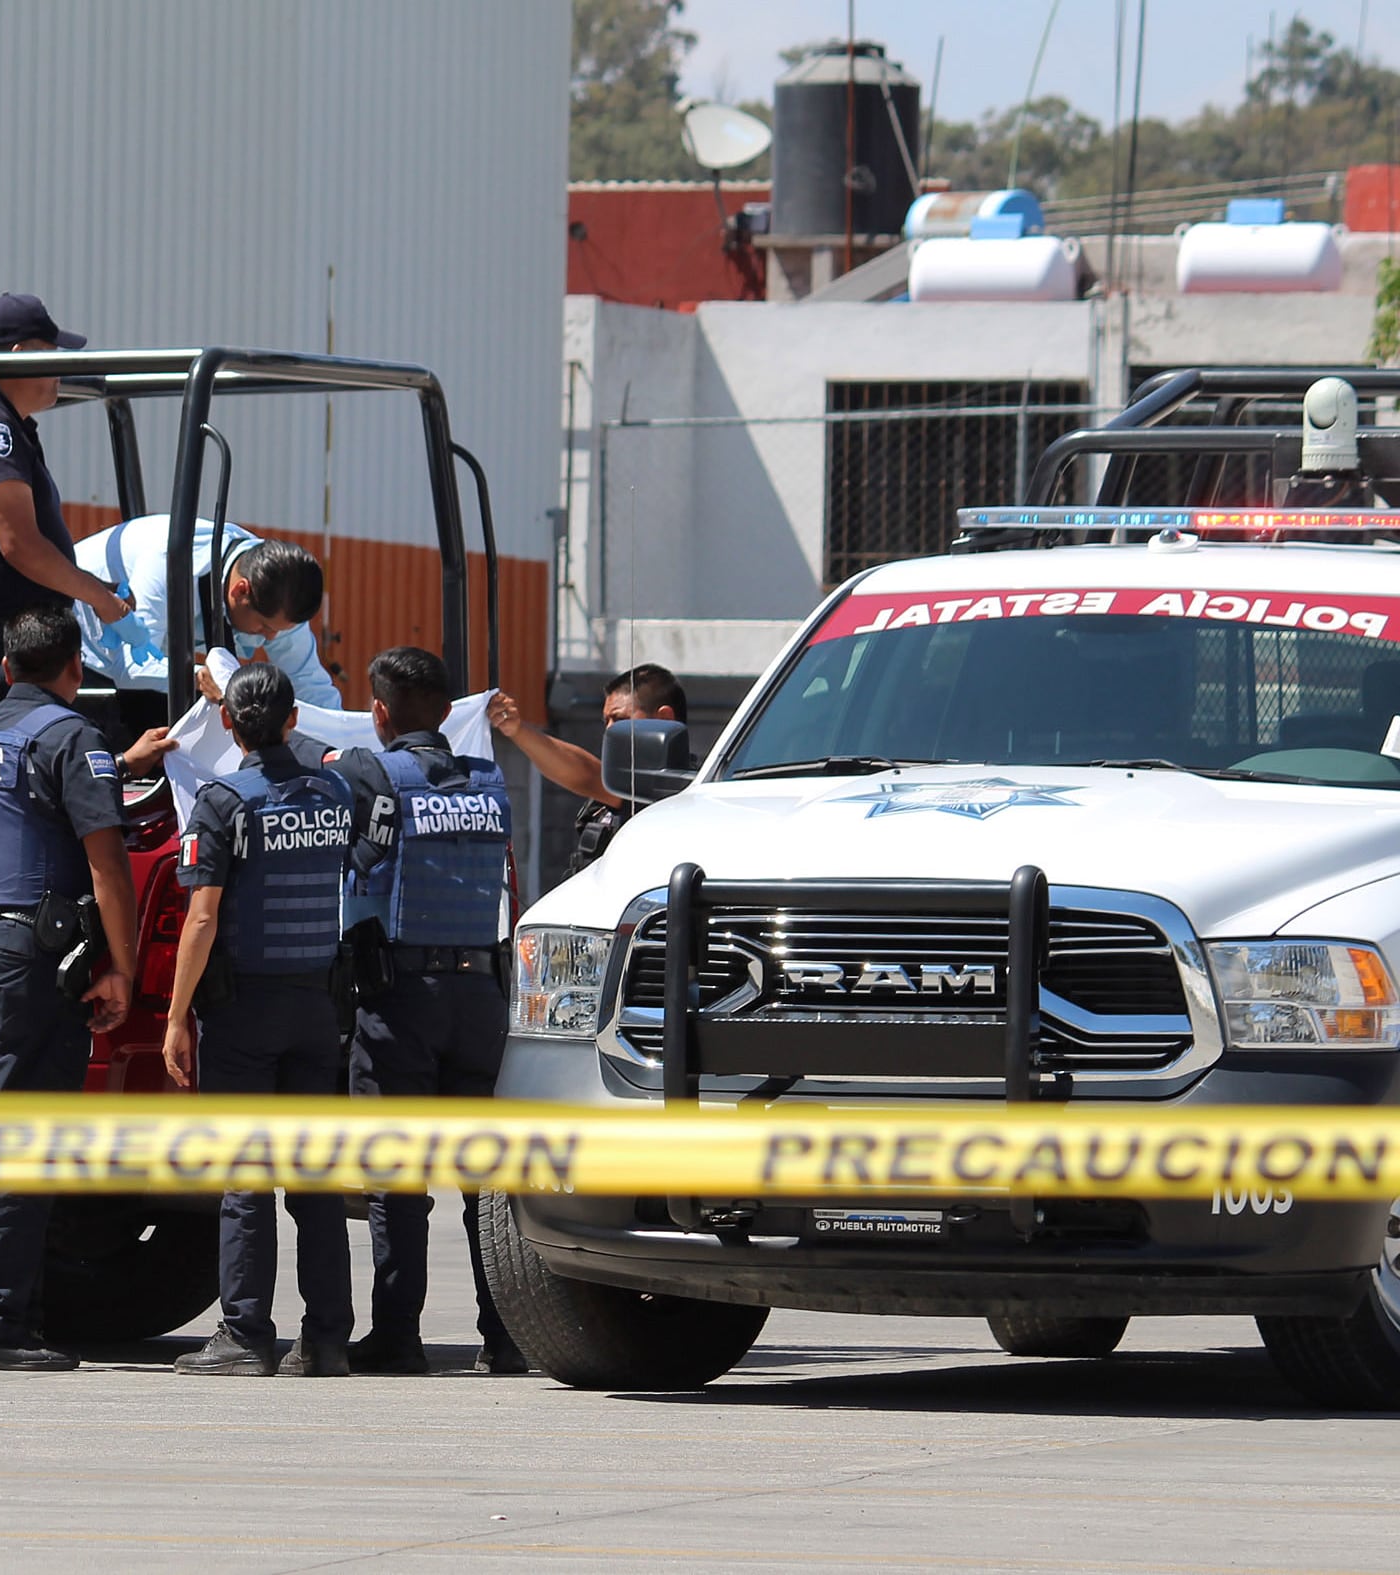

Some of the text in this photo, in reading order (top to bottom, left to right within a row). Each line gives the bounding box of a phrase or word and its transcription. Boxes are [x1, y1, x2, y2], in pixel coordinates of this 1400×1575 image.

[410, 793, 502, 817] POLICÍA
[261, 804, 353, 834] POLICÍA
[414, 814, 505, 835] MUNICIPAL
[263, 828, 350, 852] MUNICIPAL
[782, 962, 996, 995] RAM
[760, 1130, 1388, 1184] PRECAUCION
[833, 1221, 942, 1233] PUEBLA AUTOMOTRIZ
